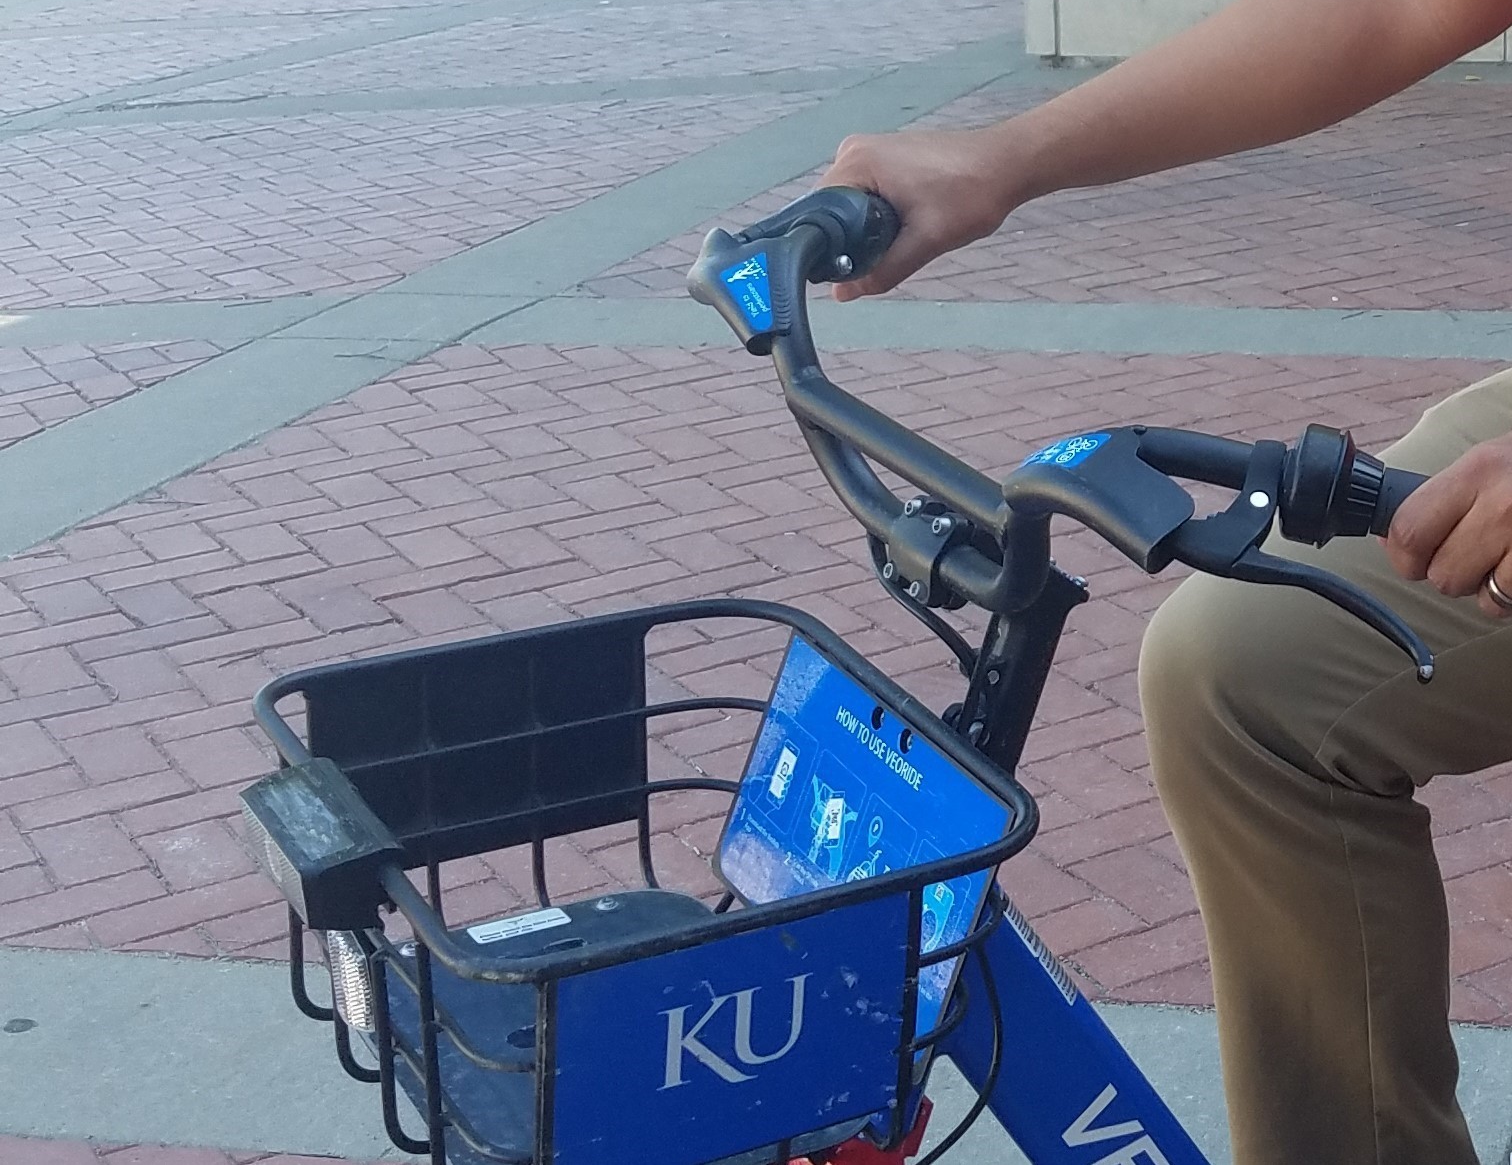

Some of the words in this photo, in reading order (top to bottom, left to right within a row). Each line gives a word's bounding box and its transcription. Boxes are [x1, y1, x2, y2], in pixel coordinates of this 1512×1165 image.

[835, 705, 860, 734] HOW
[856, 722, 870, 744] TO
[868, 733, 887, 760] USE
[884, 747, 924, 792] VEORIDE
[656, 972, 814, 1091] KU
